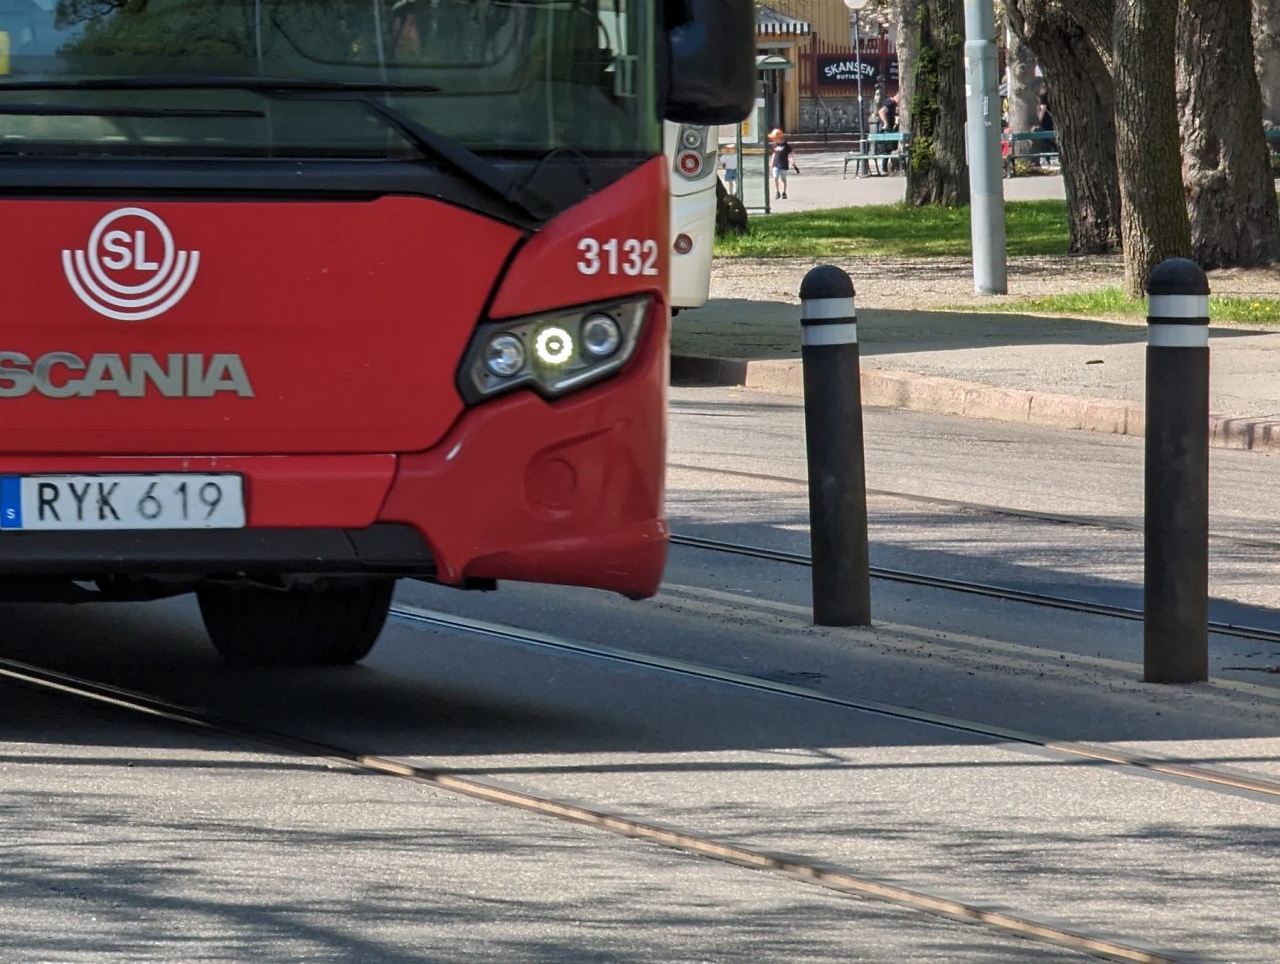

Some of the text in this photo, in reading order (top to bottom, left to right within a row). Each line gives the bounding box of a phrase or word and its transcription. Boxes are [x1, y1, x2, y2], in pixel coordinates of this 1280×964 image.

[824, 61, 875, 77] SKANSEN
[102, 230, 159, 270] SL
[576, 238, 658, 276] 3132
[7, 509, 15, 520] S
[37, 482, 223, 521] RYK 619
